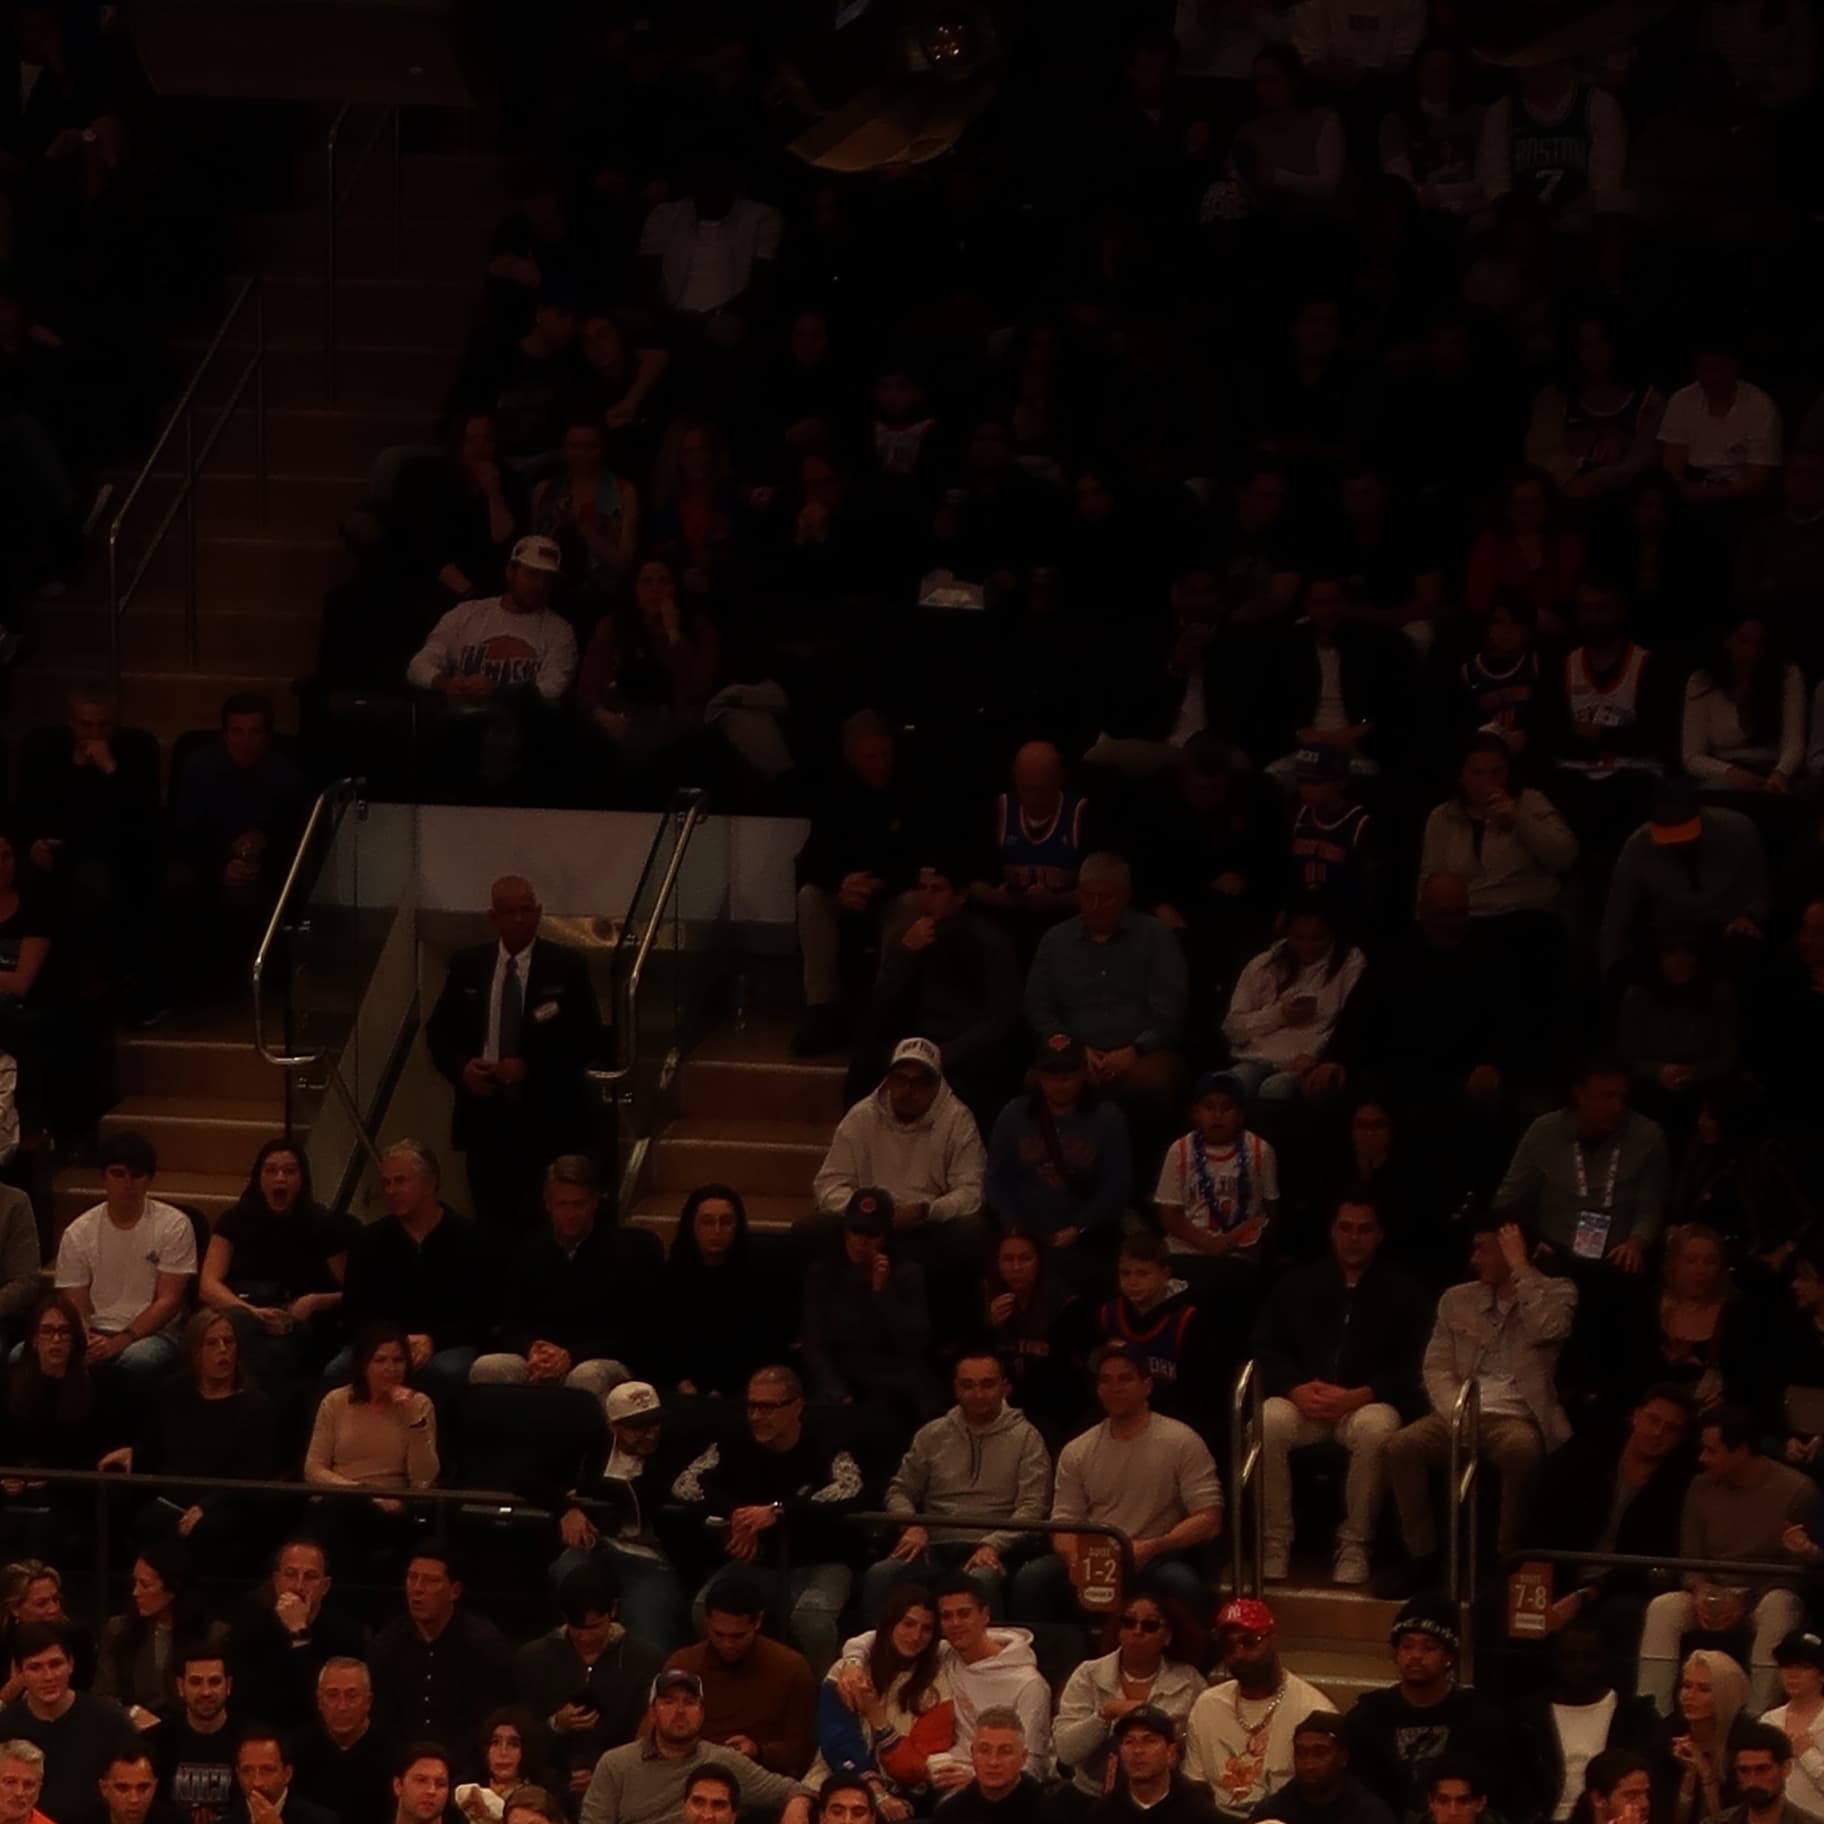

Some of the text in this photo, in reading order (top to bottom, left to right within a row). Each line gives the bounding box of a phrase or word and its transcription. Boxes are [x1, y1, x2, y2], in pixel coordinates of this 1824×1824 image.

[1535, 168, 1567, 205] 7
[1082, 1557, 1117, 1584] 1-2
[1514, 1584, 1548, 1611] 7-8
